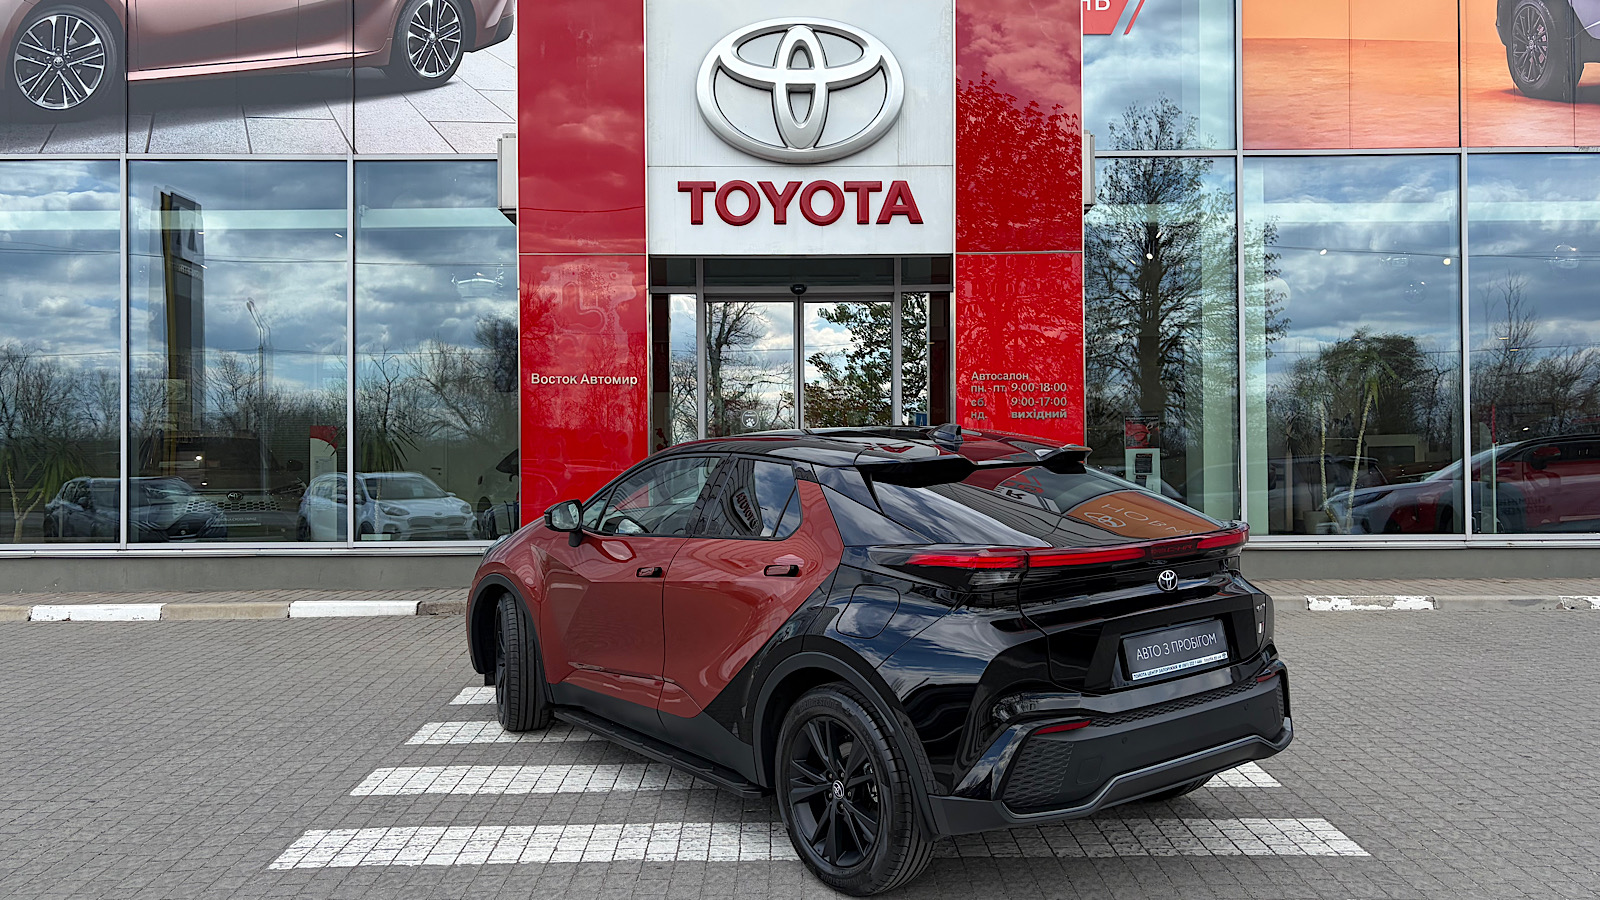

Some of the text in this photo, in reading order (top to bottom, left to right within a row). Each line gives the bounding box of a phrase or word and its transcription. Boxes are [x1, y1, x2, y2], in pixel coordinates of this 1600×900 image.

[677, 180, 924, 226] TOYOTA
[531, 373, 638, 387] Восток Автомир
[971, 371, 1029, 380] Автосалон
[971, 398, 987, 407] сб.
[971, 409, 1067, 420] нд. вихідний
[1137, 644, 1162, 661] АВТО
[1171, 633, 1217, 653] ПРОБІГОМ
